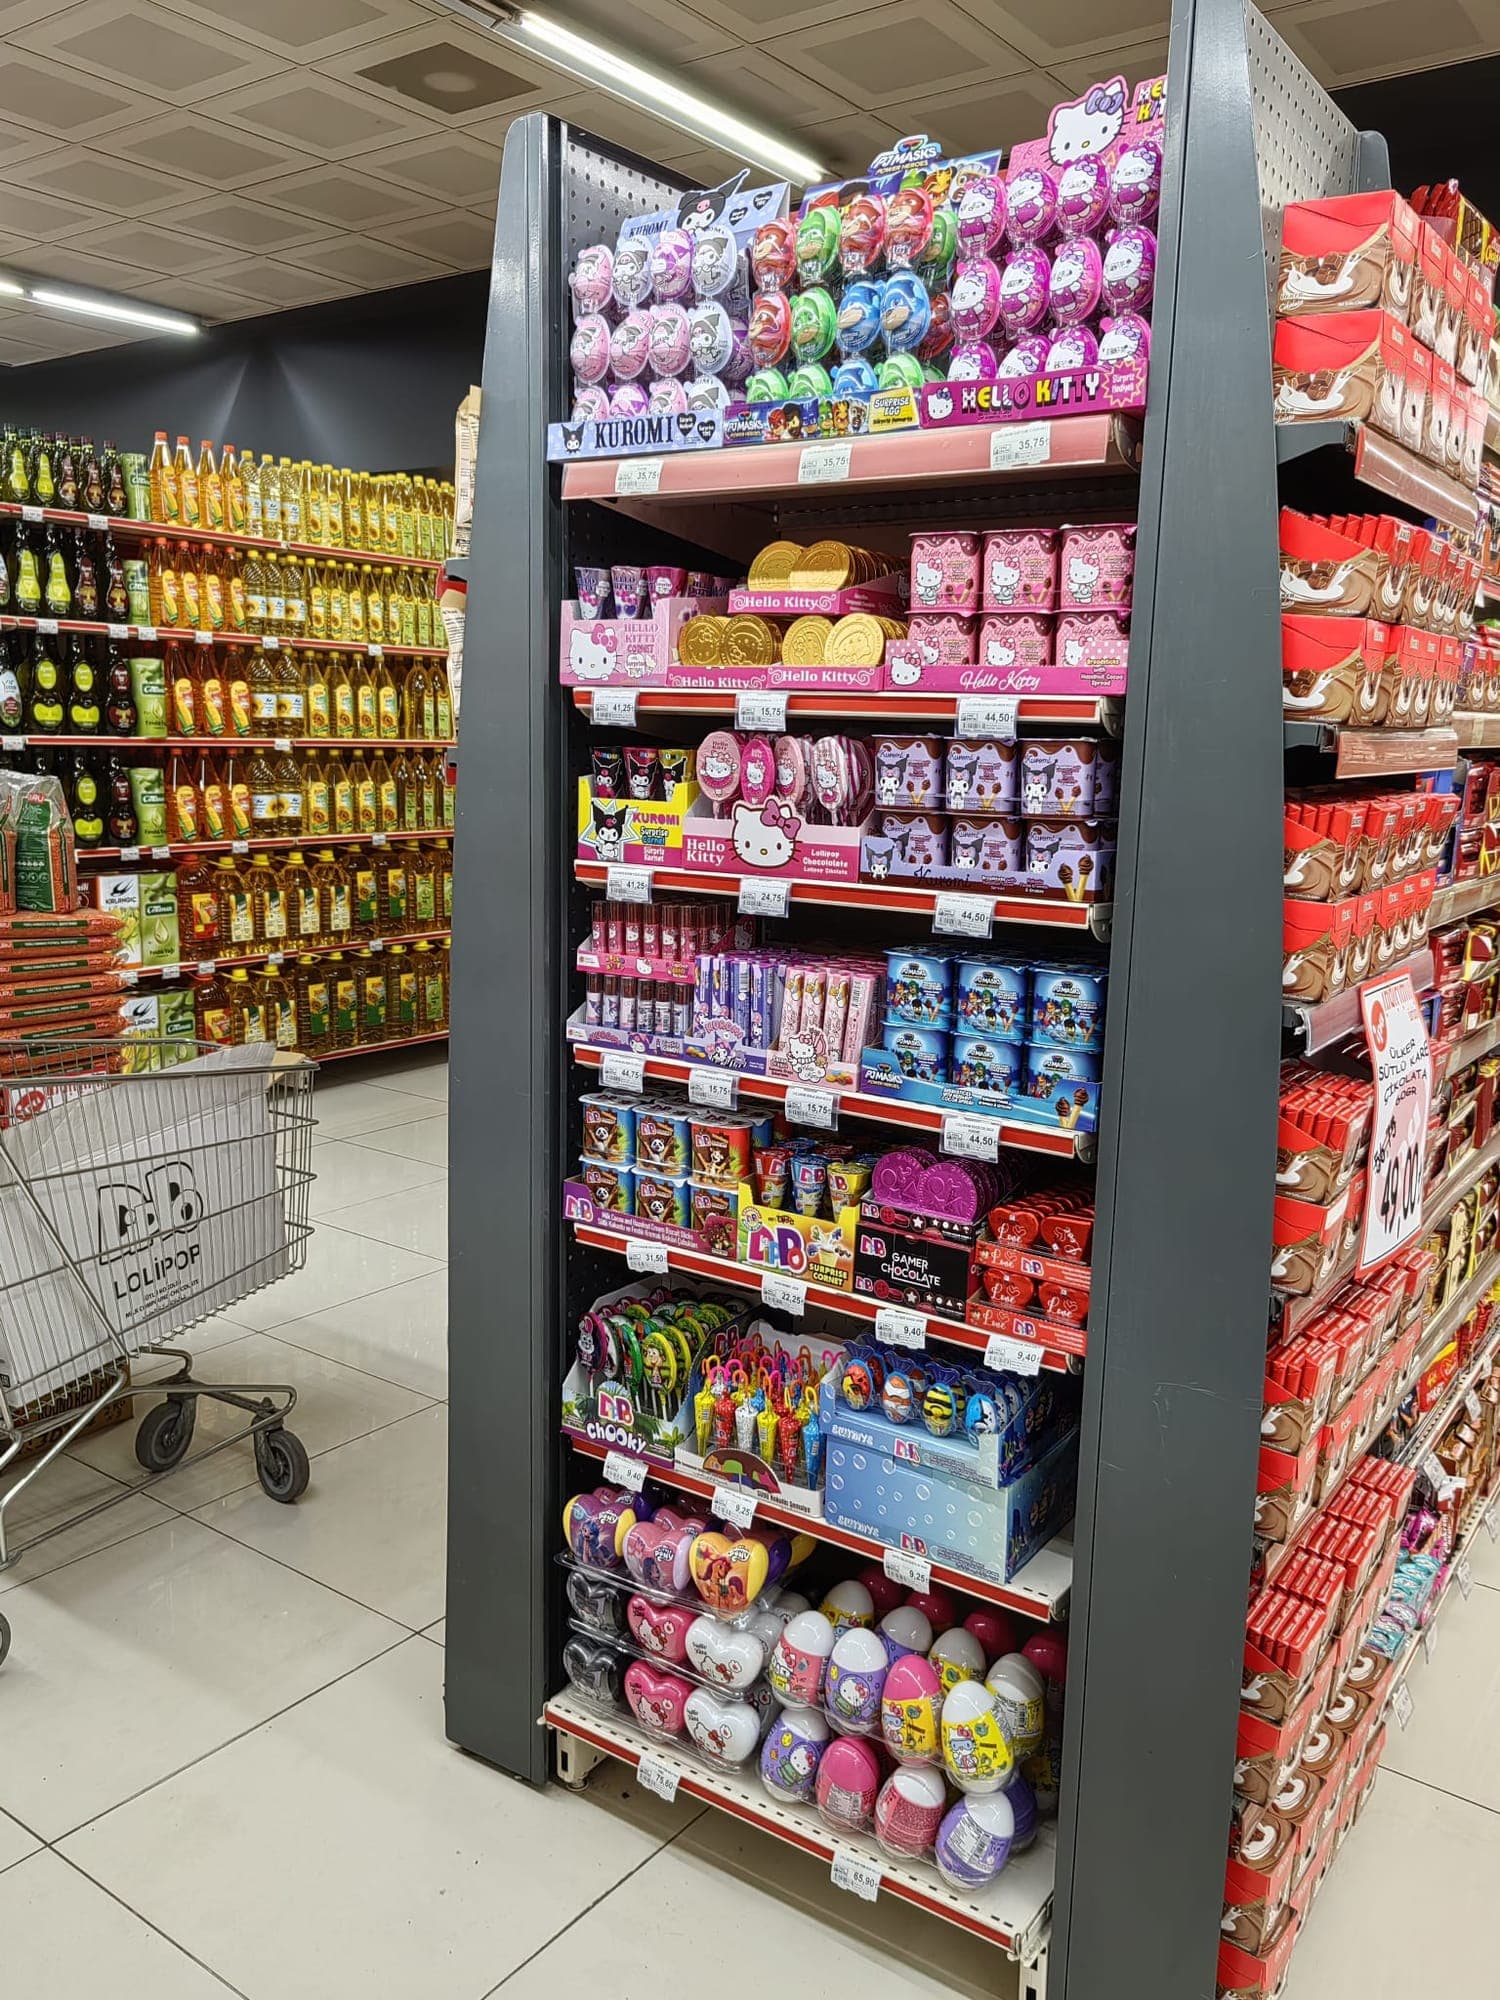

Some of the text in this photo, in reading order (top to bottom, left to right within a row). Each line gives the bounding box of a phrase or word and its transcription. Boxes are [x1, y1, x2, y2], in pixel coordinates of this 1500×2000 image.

[962, 371, 1100, 414] HELLO KITTY
[874, 396, 911, 409] SURPRISE
[884, 406, 900, 417] EGG
[594, 415, 674, 449] KUROMI
[745, 596, 819, 610] Hello Kitty
[624, 624, 658, 633] HELLO
[625, 634, 657, 644] KITTY
[682, 677, 750, 688] Hello Kitty
[783, 671, 857, 684] Hello Kitty
[960, 669, 1041, 690] Hello Kitty
[633, 812, 680, 825] KUROMI
[640, 826, 669, 837] Surprise
[687, 838, 725, 852] Hello
[687, 850, 725, 866] Kitty
[913, 866, 971, 888] Kuromi
[1389, 1038, 1416, 1059] ÜLKER
[1379, 1040, 1429, 1081] SÜTLÜ KARE
[1384, 1069, 1427, 1106] ÇİKOLATA
[892, 1252, 928, 1270] GAMER
[114, 1244, 201, 1300] LOLİPOP
[809, 1263, 848, 1280] SURPRISE
[813, 1272, 843, 1285] CORNET
[881, 1263, 941, 1288] CHOCOLATE
